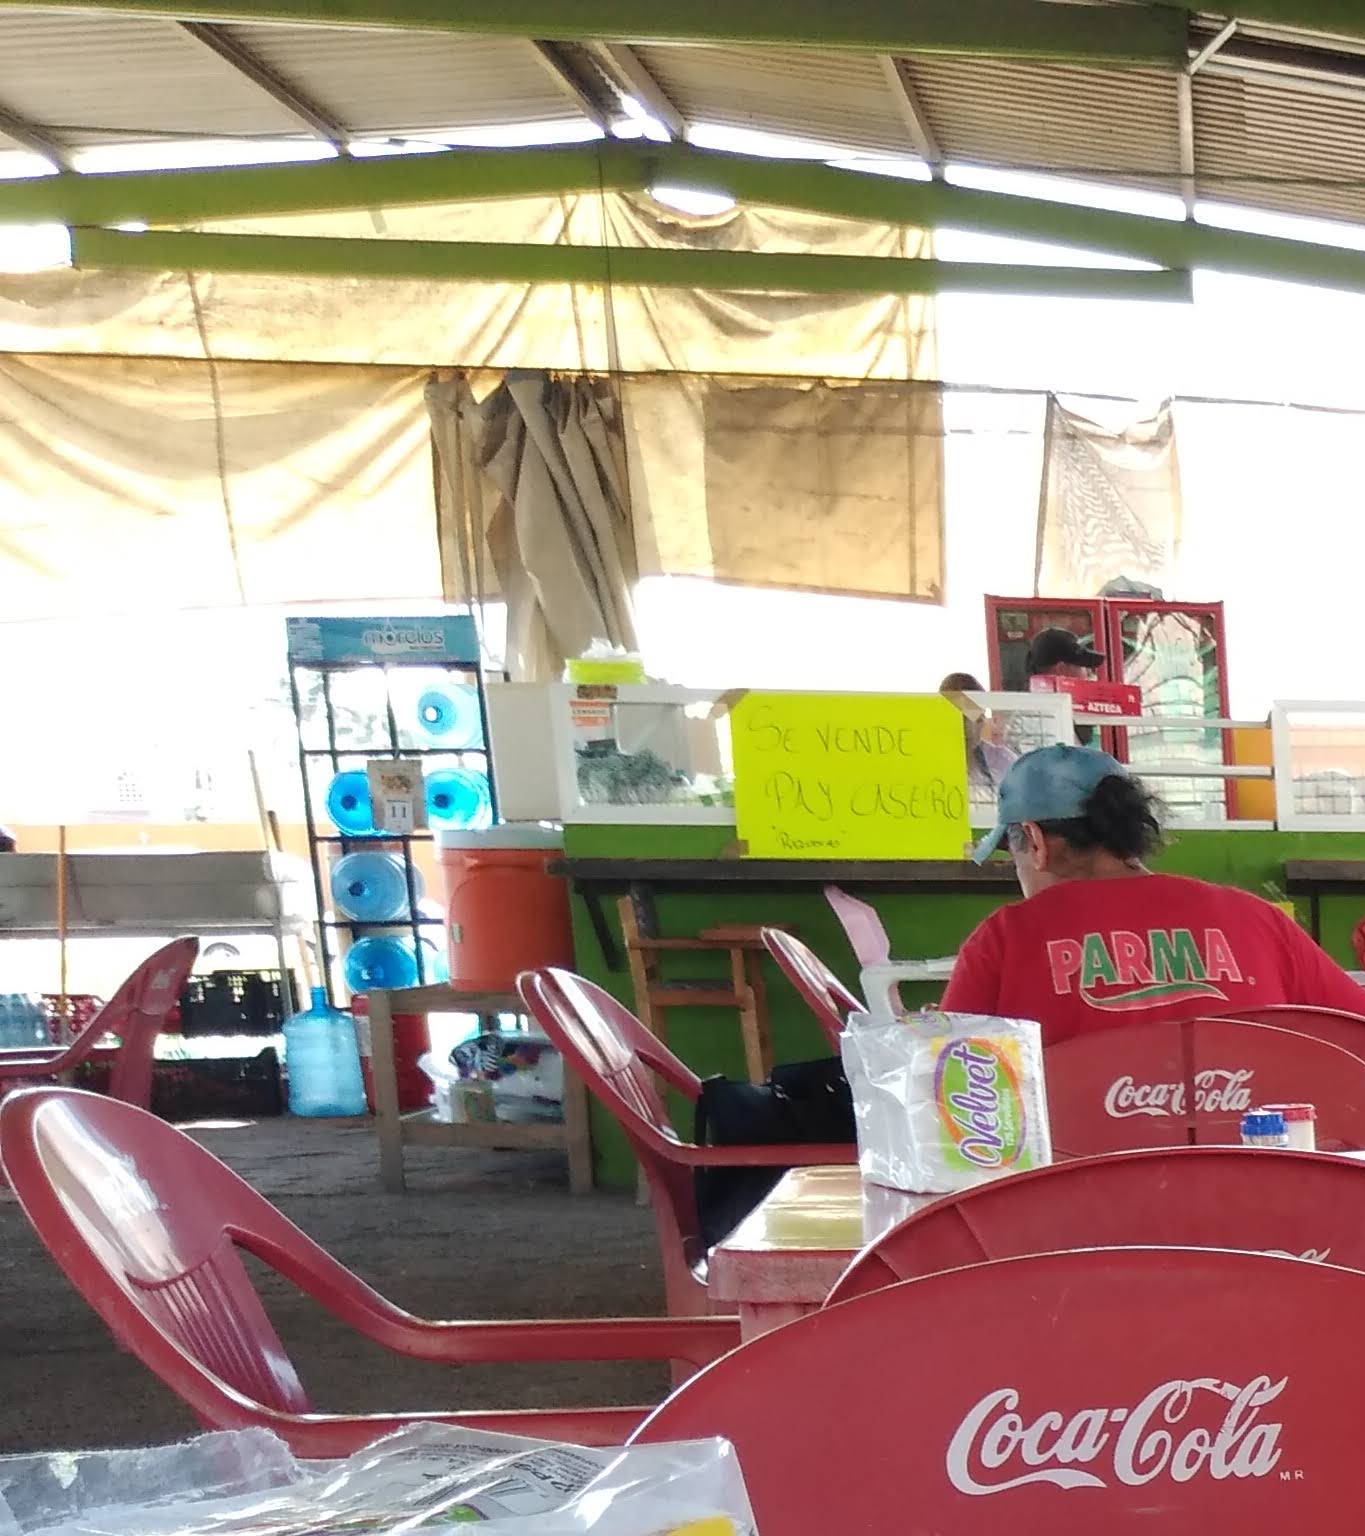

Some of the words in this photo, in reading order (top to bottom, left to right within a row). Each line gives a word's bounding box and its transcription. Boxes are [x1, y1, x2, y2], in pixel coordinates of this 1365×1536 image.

[748, 705, 801, 753] SE
[816, 723, 913, 757] VENDE
[850, 778, 964, 820] CASERO
[1046, 928, 1244, 995] PARMA
[951, 1043, 1003, 1168] Velvet
[1104, 1069, 1255, 1118] Coca-Cola
[946, 1375, 1288, 1496] Coca-Cola
